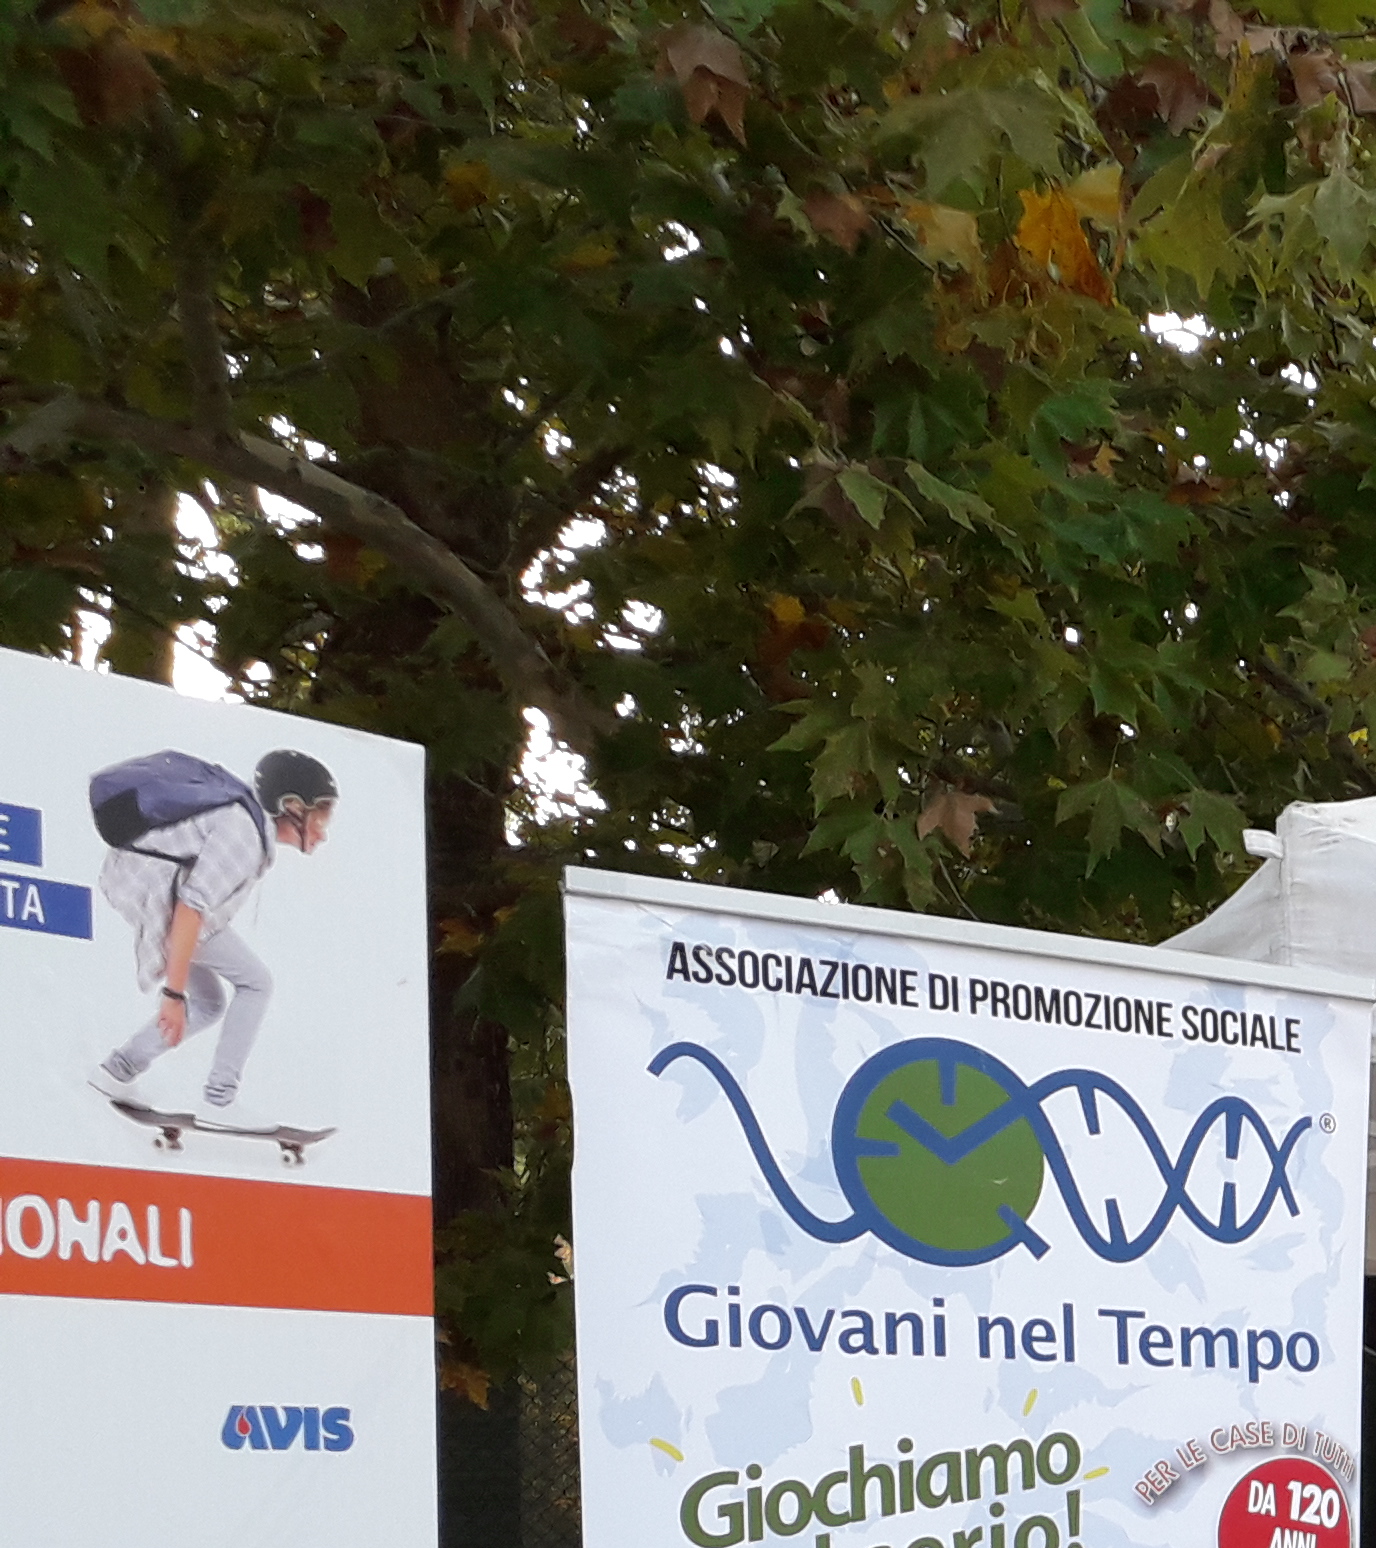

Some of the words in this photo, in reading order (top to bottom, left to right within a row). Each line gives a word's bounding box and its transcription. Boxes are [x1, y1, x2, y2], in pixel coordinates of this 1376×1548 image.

[666, 941, 918, 1009] ASSOCIAZIONE
[929, 973, 963, 1013] DI
[968, 977, 1174, 1039] PROMOZIONE
[1181, 1005, 1302, 1054] SOCIALE
[0, 1193, 194, 1268] ONALI
[662, 1282, 946, 1358] Giovani
[977, 1302, 1076, 1365] nel
[1098, 1308, 1321, 1383] Tempo
[221, 1405, 354, 1451] AVIS
[1134, 1459, 1178, 1504] PER
[1176, 1438, 1206, 1469] LE
[1210, 1421, 1273, 1452] CASE
[1283, 1422, 1306, 1449] DI
[1247, 1479, 1276, 1516] DA
[1287, 1480, 1340, 1528] 120
